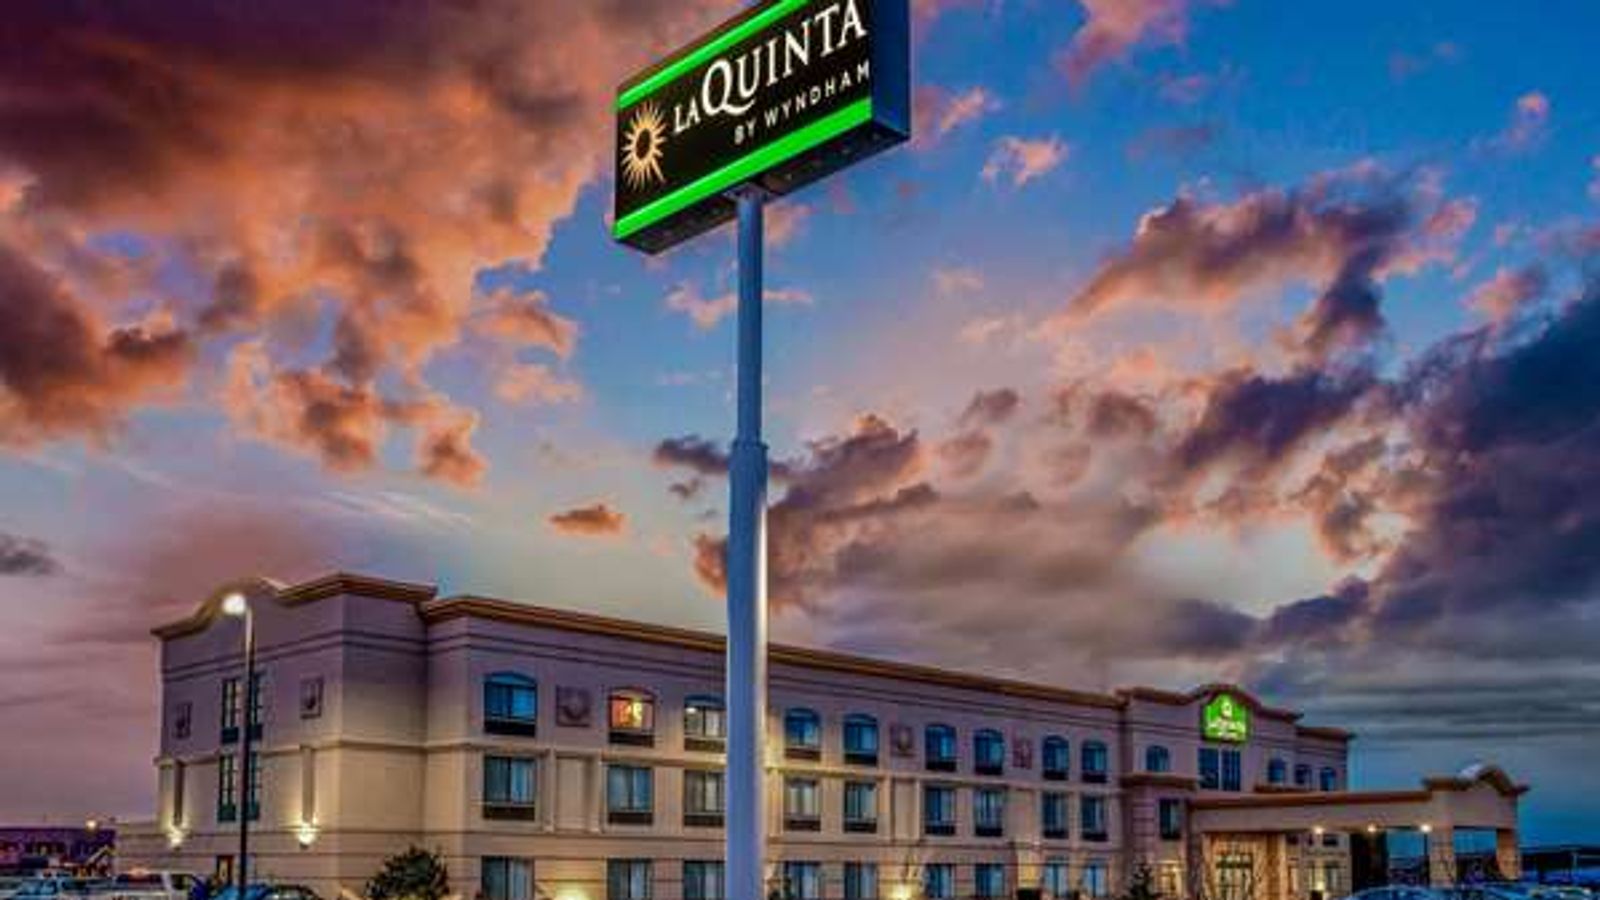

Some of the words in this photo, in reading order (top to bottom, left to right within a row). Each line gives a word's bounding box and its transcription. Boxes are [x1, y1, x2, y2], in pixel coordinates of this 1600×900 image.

[701, 0, 868, 117] QUINTA
[734, 120, 756, 145] BY
[763, 59, 870, 128] WYNDHAM
